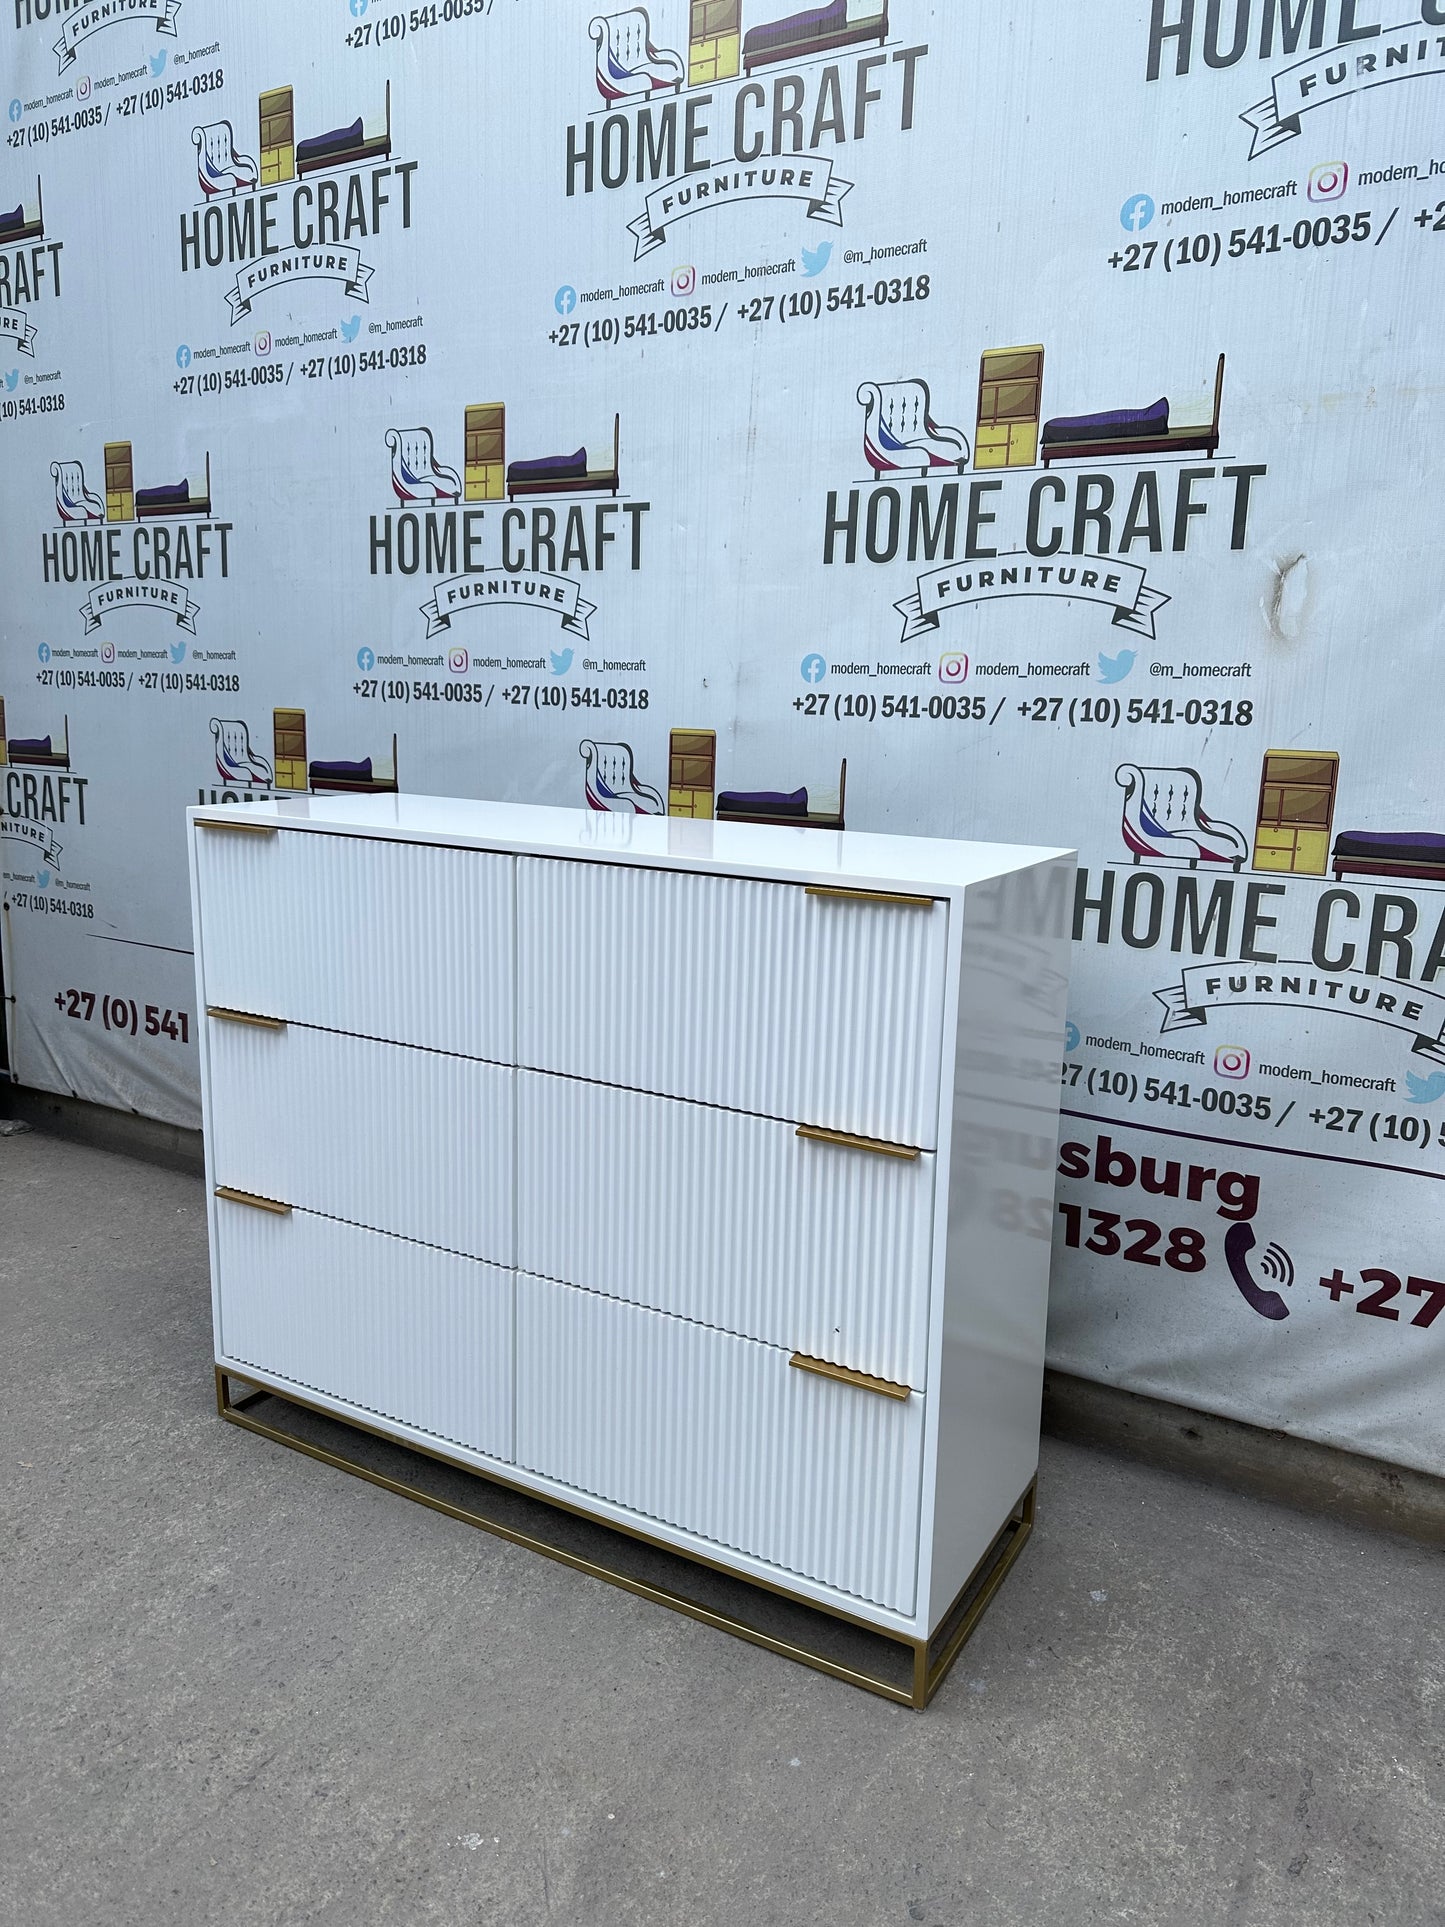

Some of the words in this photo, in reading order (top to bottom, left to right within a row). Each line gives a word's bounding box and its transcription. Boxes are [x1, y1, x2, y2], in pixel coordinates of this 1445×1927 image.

[345, 23, 372, 48] +27
[375, 14, 406, 46] (10)
[7, 128, 25, 148] +27
[28, 121, 49, 147] (10)
[51, 106, 101, 137] 541-0035
[116, 95, 137, 116] +27
[140, 87, 164, 115] (10)
[166, 69, 224, 103] 541-0318
[565, 94, 713, 197] HOME
[733, 44, 929, 162] CRAFT
[662, 168, 814, 214] FURNITURE
[180, 193, 280, 272] HOME
[293, 161, 418, 249] CRAFT
[1107, 240, 1158, 272] +27
[1164, 232, 1221, 272] (10)
[1227, 211, 1372, 258] 541-0035
[1375, 207, 1399, 245] /
[247, 254, 348, 288] FURNITURE
[843, 239, 928, 265] @m_homecraft
[548, 322, 580, 347] +27
[584, 317, 619, 348] (10)
[624, 305, 712, 338] 541-0035
[714, 303, 728, 331] /
[737, 295, 774, 323] +27
[779, 288, 822, 323] (10)
[826, 275, 930, 313] 541-0318
[173, 376, 195, 396] +27
[197, 372, 222, 396] (10)
[224, 364, 283, 389] 541-0035
[286, 362, 294, 385] /
[300, 358, 325, 379] +27
[328, 354, 356, 380] (10)
[359, 344, 427, 372] 541-0318
[19, 394, 65, 416] 541-0318
[370, 510, 485, 575] HOME
[502, 501, 651, 573] CRAFT
[823, 480, 1002, 564] HOME
[1025, 464, 1267, 557] CRAFT
[42, 529, 123, 582] HOME
[133, 523, 233, 580] CRAFT
[97, 586, 179, 606] FURNITURE
[447, 580, 565, 604] FURNITURE
[937, 566, 1122, 598] FURNITURE
[36, 670, 54, 686] +27
[55, 670, 76, 690] (10)
[77, 671, 126, 688] 541-0035
[138, 672, 159, 689] +27
[161, 673, 184, 694] (10)
[185, 673, 240, 692] 541-0318
[582, 659, 646, 673] @m_homecraft
[1149, 662, 1251, 682] @m_homecraft
[353, 679, 378, 699] +27
[381, 680, 410, 703] (10)
[413, 682, 483, 703] 541-0035
[485, 684, 495, 707] /
[502, 685, 531, 705] +27
[534, 686, 567, 711] (10)
[570, 687, 649, 710] 541-0318
[792, 693, 829, 717] +27
[833, 694, 876, 722] (10)
[881, 694, 986, 721] 541-0035
[989, 696, 1004, 725] /
[1017, 697, 1060, 722] +27
[1068, 697, 1120, 728] (10)
[1126, 698, 1254, 727] 541-0318
[7, 772, 88, 825] CRAFT
[12, 893, 28, 908] +27
[29, 895, 48, 914] (10)
[50, 899, 94, 919] 541-0318
[1072, 868, 1286, 963] HOME
[54, 988, 96, 1021] +27
[102, 995, 138, 1036] (0)
[145, 1005, 189, 1043] 541
[1206, 976, 1423, 1021] FURNITURE
[1087, 1068, 1138, 1102] (10)
[1144, 1077, 1271, 1120] 541-0035
[1274, 1101, 1296, 1127] /
[1309, 1107, 1364, 1136] +27
[1369, 1112, 1431, 1149] (10)
[1058, 1202, 1207, 1273] 1328
[1319, 1267, 1445, 1329] +27
